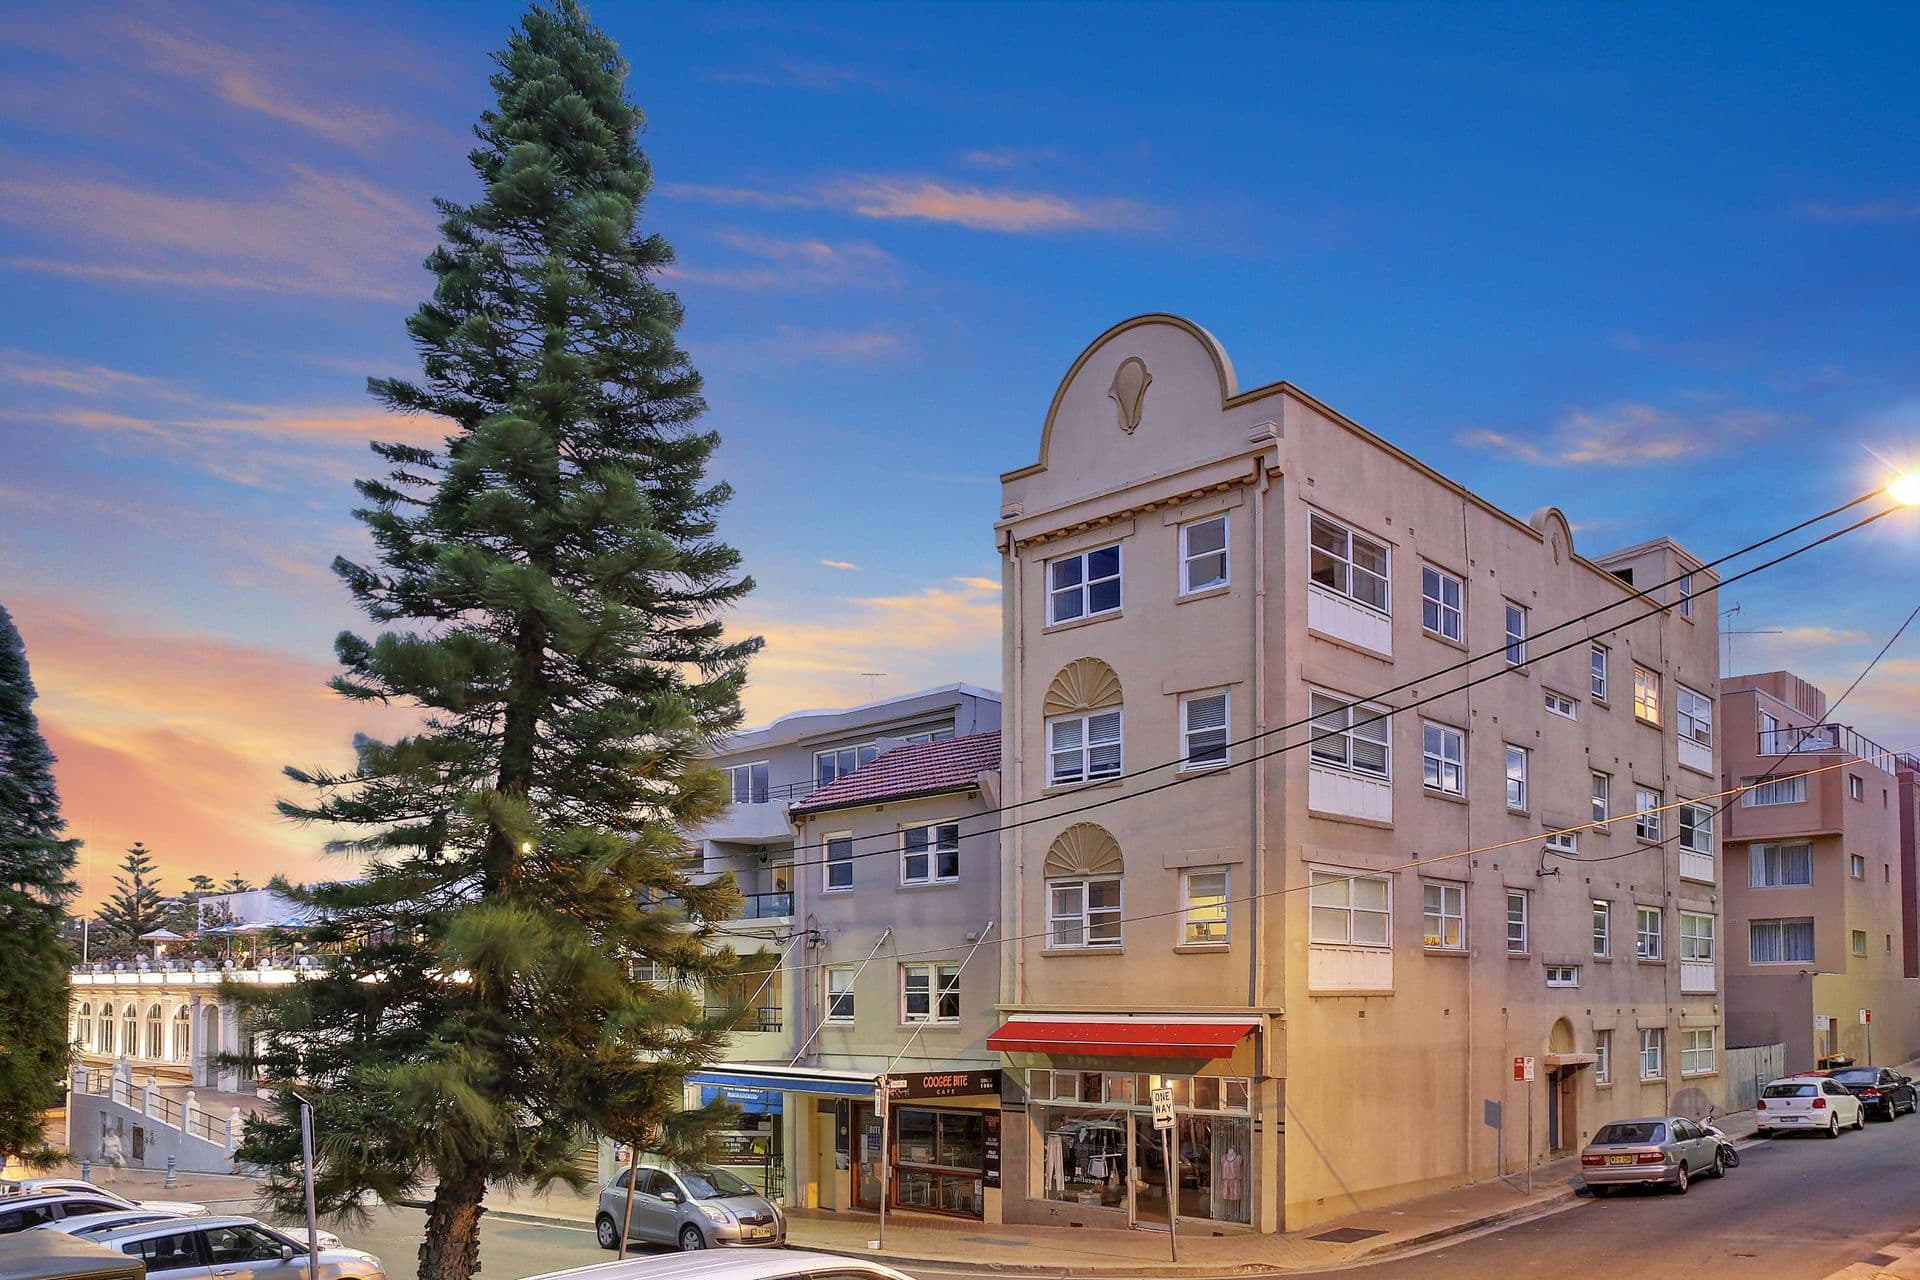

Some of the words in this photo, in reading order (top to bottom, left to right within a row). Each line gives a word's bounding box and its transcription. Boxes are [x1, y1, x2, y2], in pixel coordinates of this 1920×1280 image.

[923, 1076, 952, 1088] COOGEE
[953, 1075, 968, 1087] BITE
[1155, 1091, 1170, 1102] ONE
[1155, 1104, 1171, 1114] WAY
[1073, 1176, 1105, 1186] philosophy
